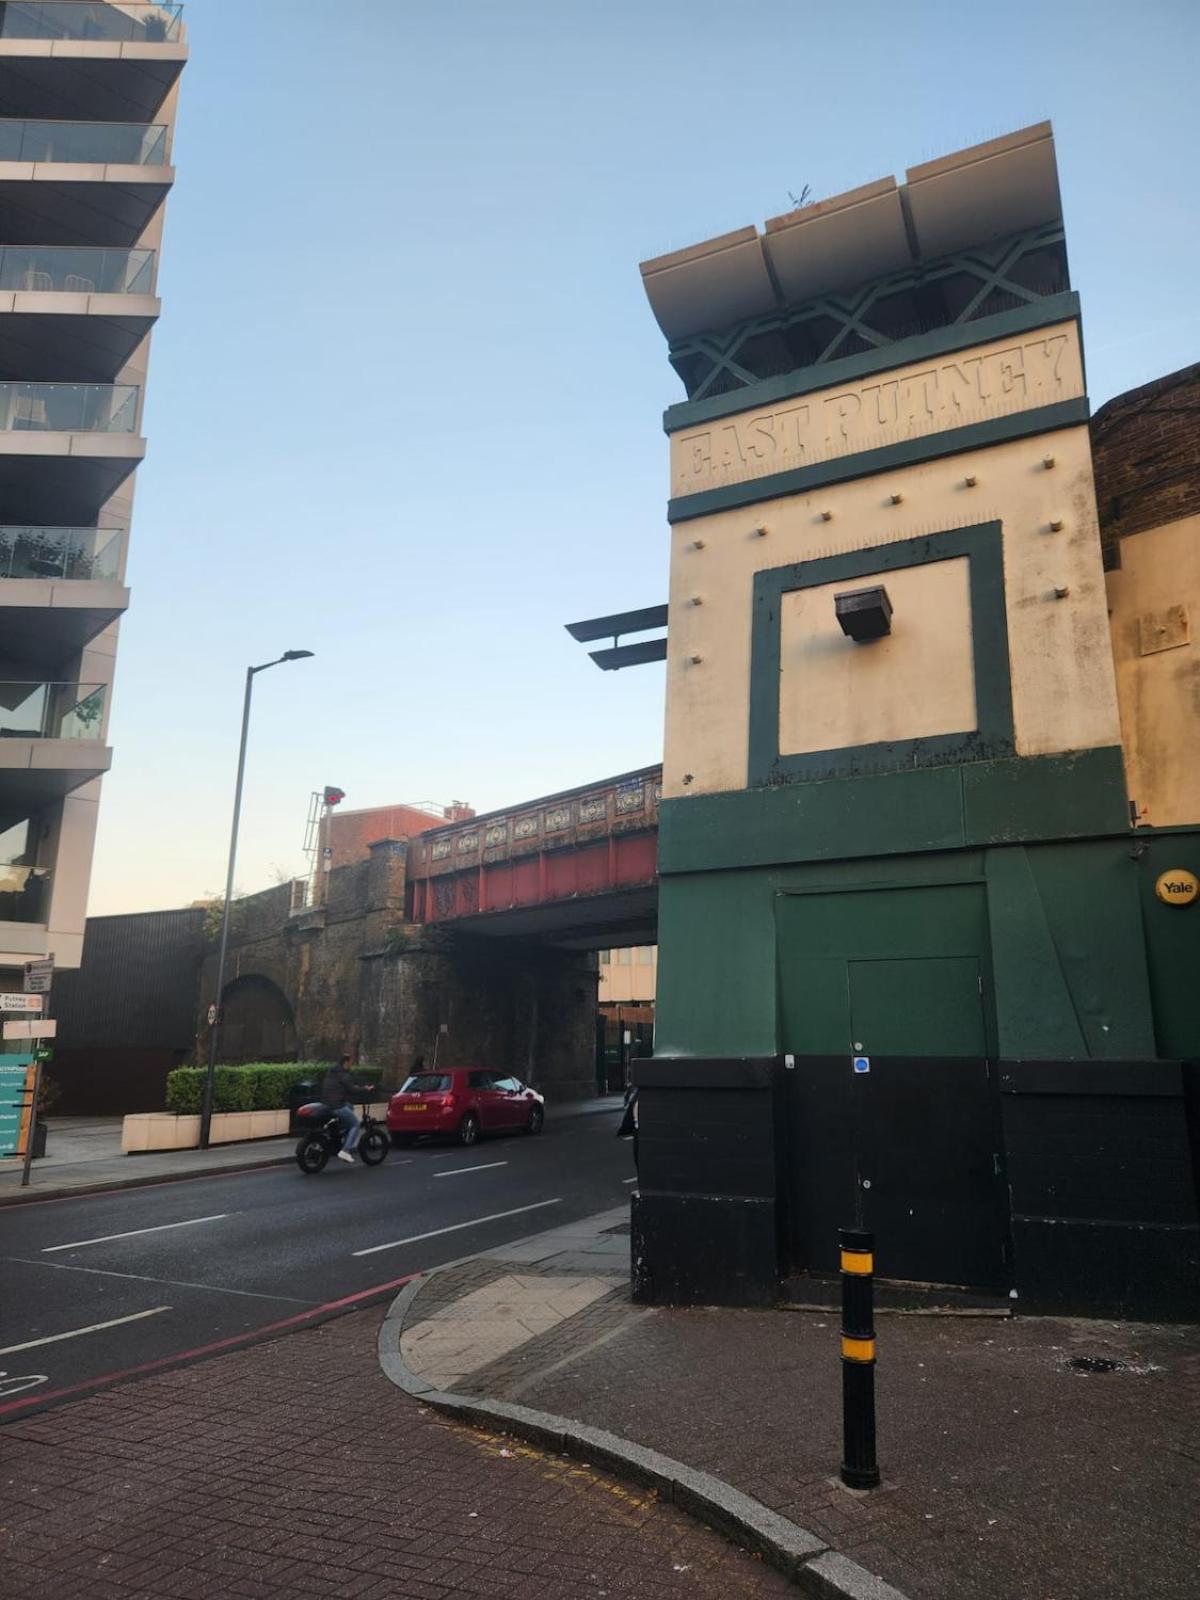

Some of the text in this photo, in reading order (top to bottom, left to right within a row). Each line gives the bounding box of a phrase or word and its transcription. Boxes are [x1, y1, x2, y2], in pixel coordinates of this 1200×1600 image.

[679, 334, 1067, 478] EAST PUTNEY
[1164, 882, 1193, 894] Yale
